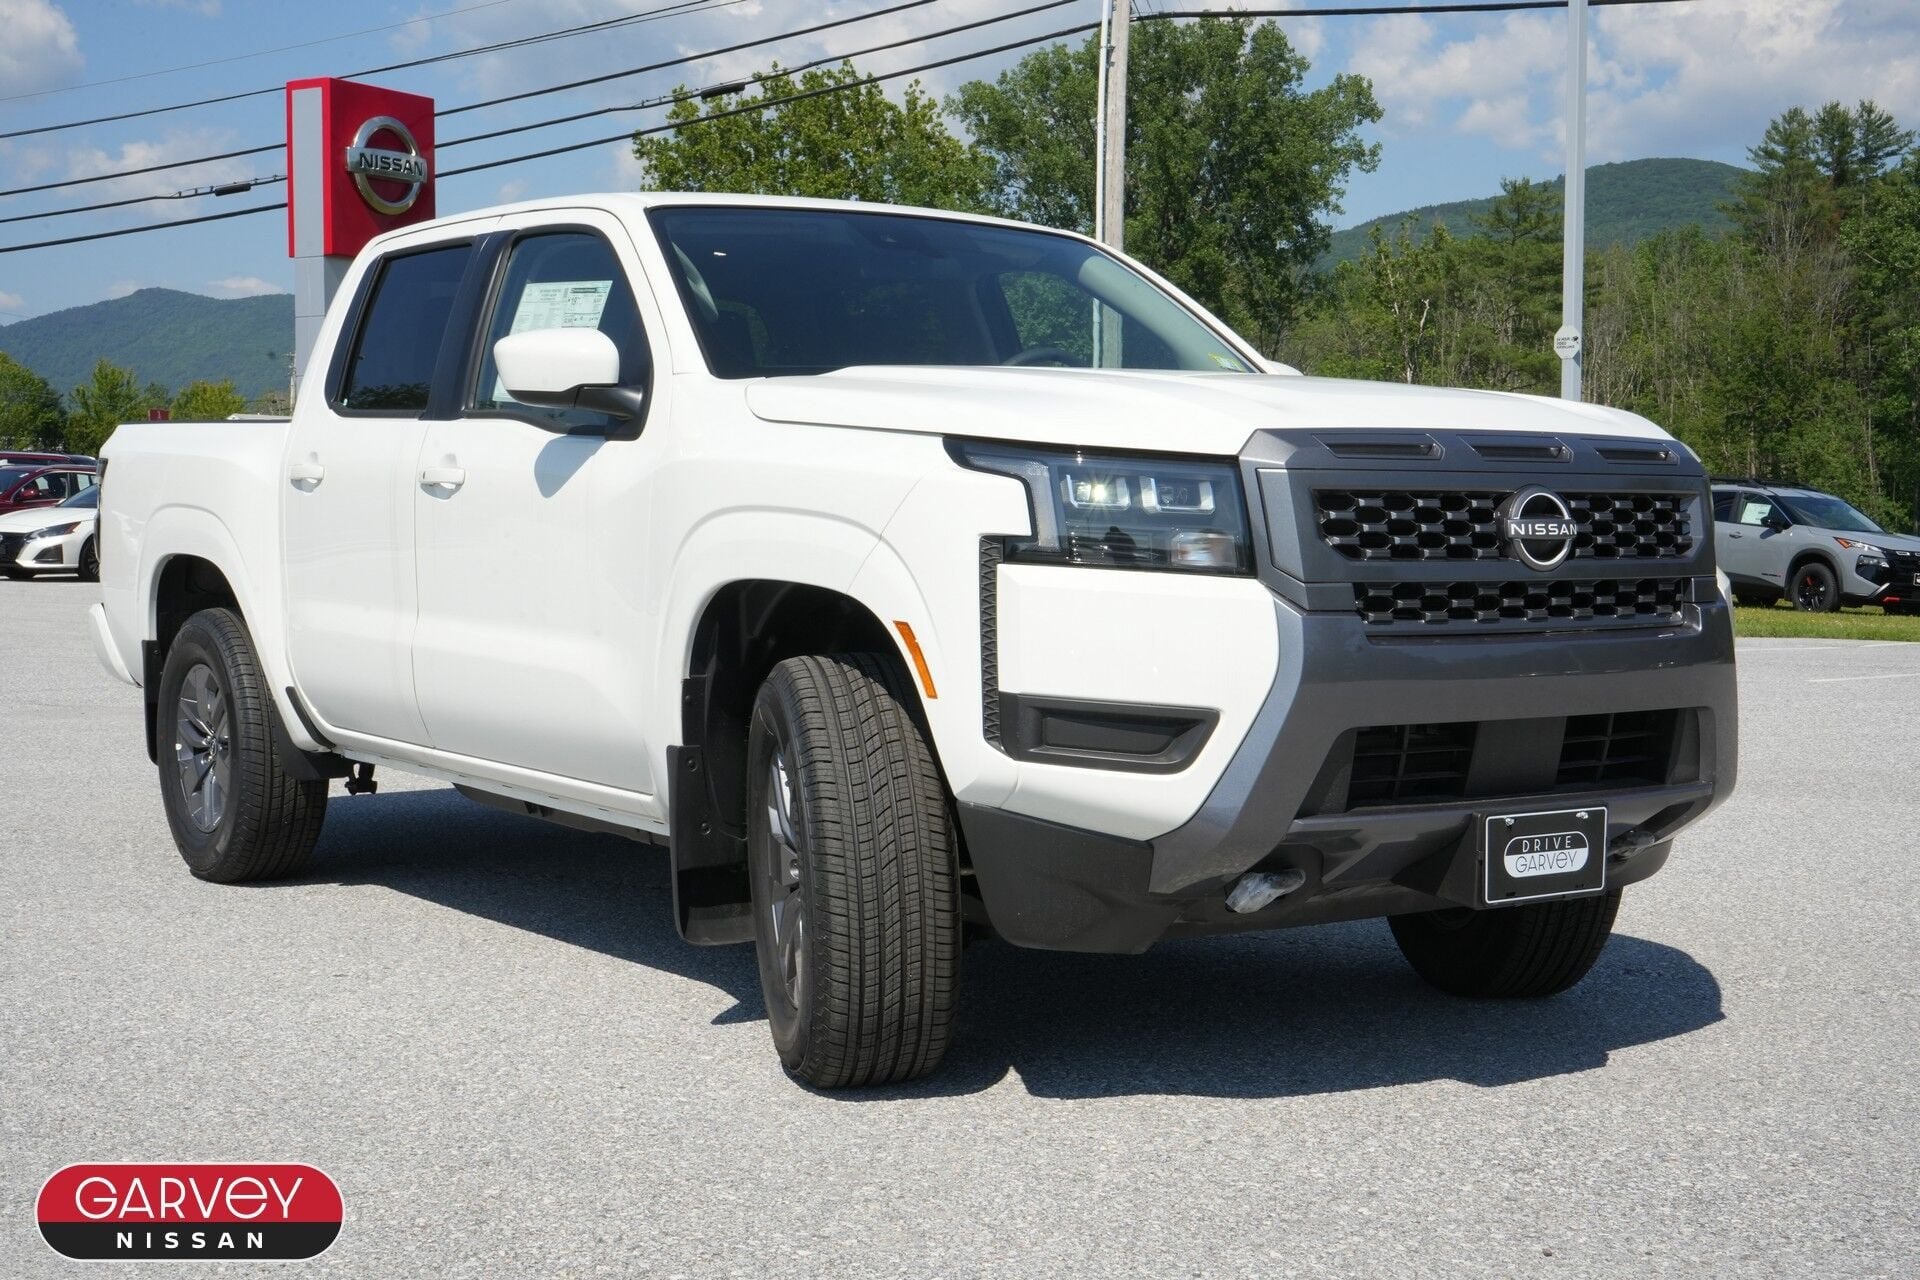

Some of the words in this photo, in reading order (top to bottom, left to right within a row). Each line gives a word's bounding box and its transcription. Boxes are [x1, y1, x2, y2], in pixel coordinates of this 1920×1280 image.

[359, 152, 423, 176] NISSAN
[1510, 523, 1577, 536] NISSAN
[1522, 835, 1572, 853] DRIVE
